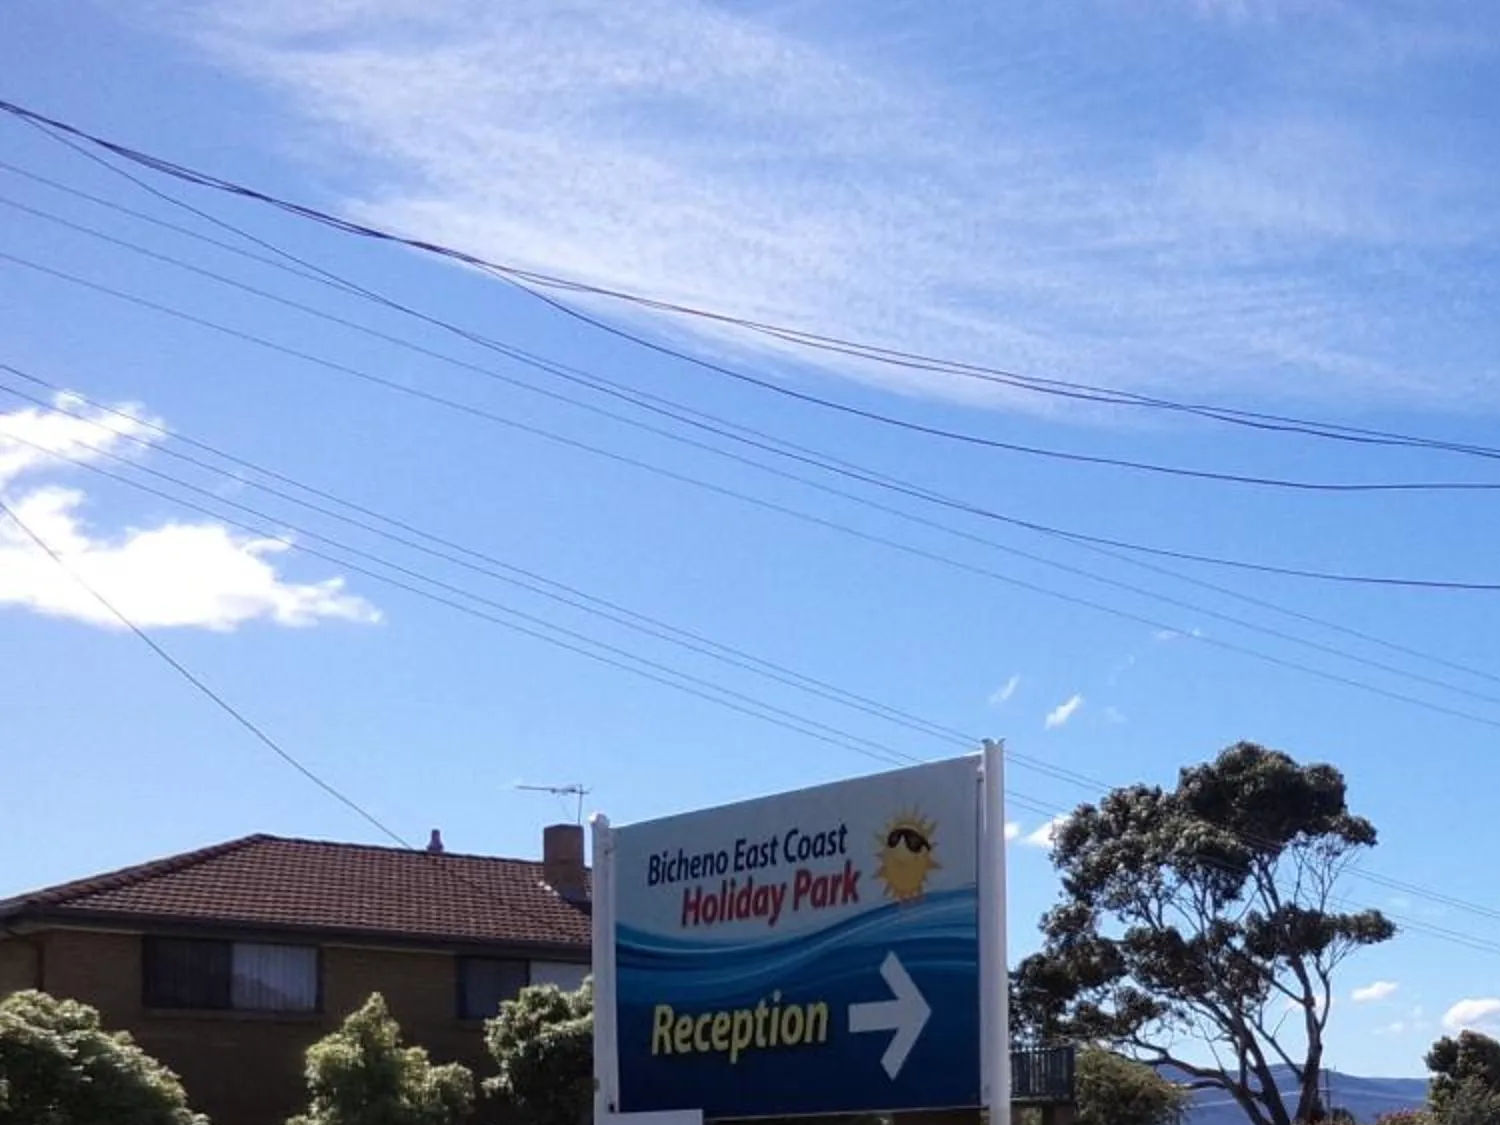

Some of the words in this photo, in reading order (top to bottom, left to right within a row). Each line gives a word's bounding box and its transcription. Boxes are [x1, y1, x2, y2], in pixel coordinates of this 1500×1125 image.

[648, 847, 729, 887] Bicheno
[733, 836, 778, 872] East
[783, 823, 848, 862] Coast
[681, 878, 787, 928] Holiday
[793, 860, 860, 912] Park
[651, 989, 829, 1064] Reception
